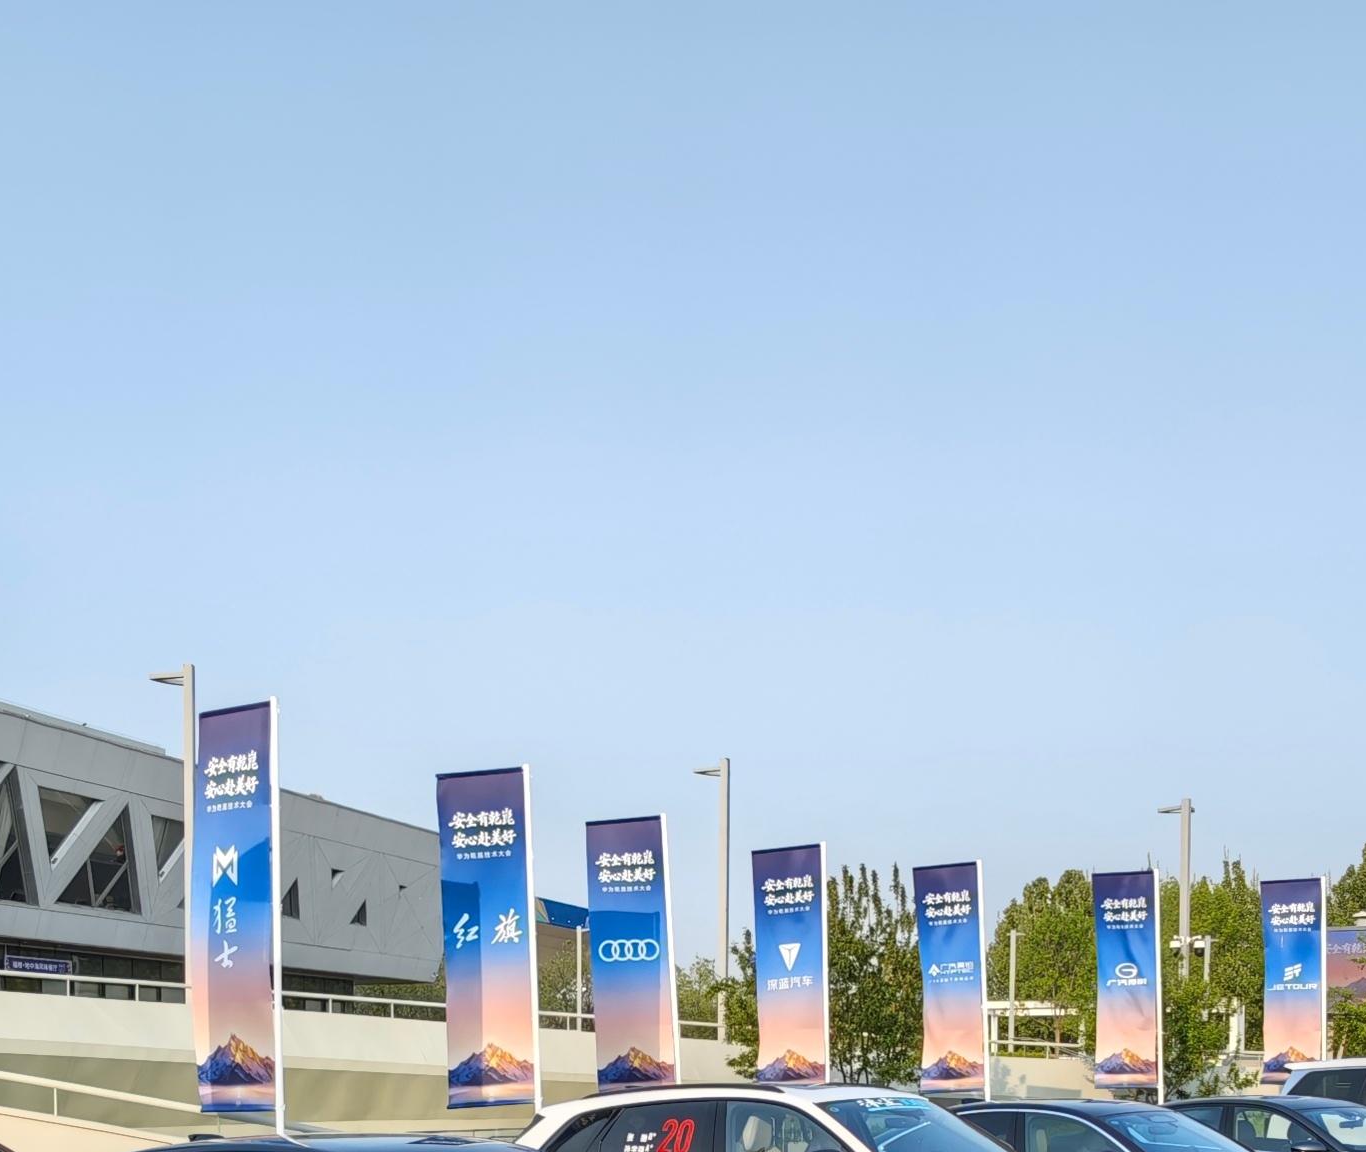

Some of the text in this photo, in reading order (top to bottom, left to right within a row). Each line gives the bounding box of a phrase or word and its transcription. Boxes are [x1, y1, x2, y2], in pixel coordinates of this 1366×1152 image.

[204, 774, 259, 799] 安心赴美好
[451, 828, 517, 848] 安心赴美好
[452, 907, 523, 949] 红旗
[1267, 982, 1319, 991] JETOUR
